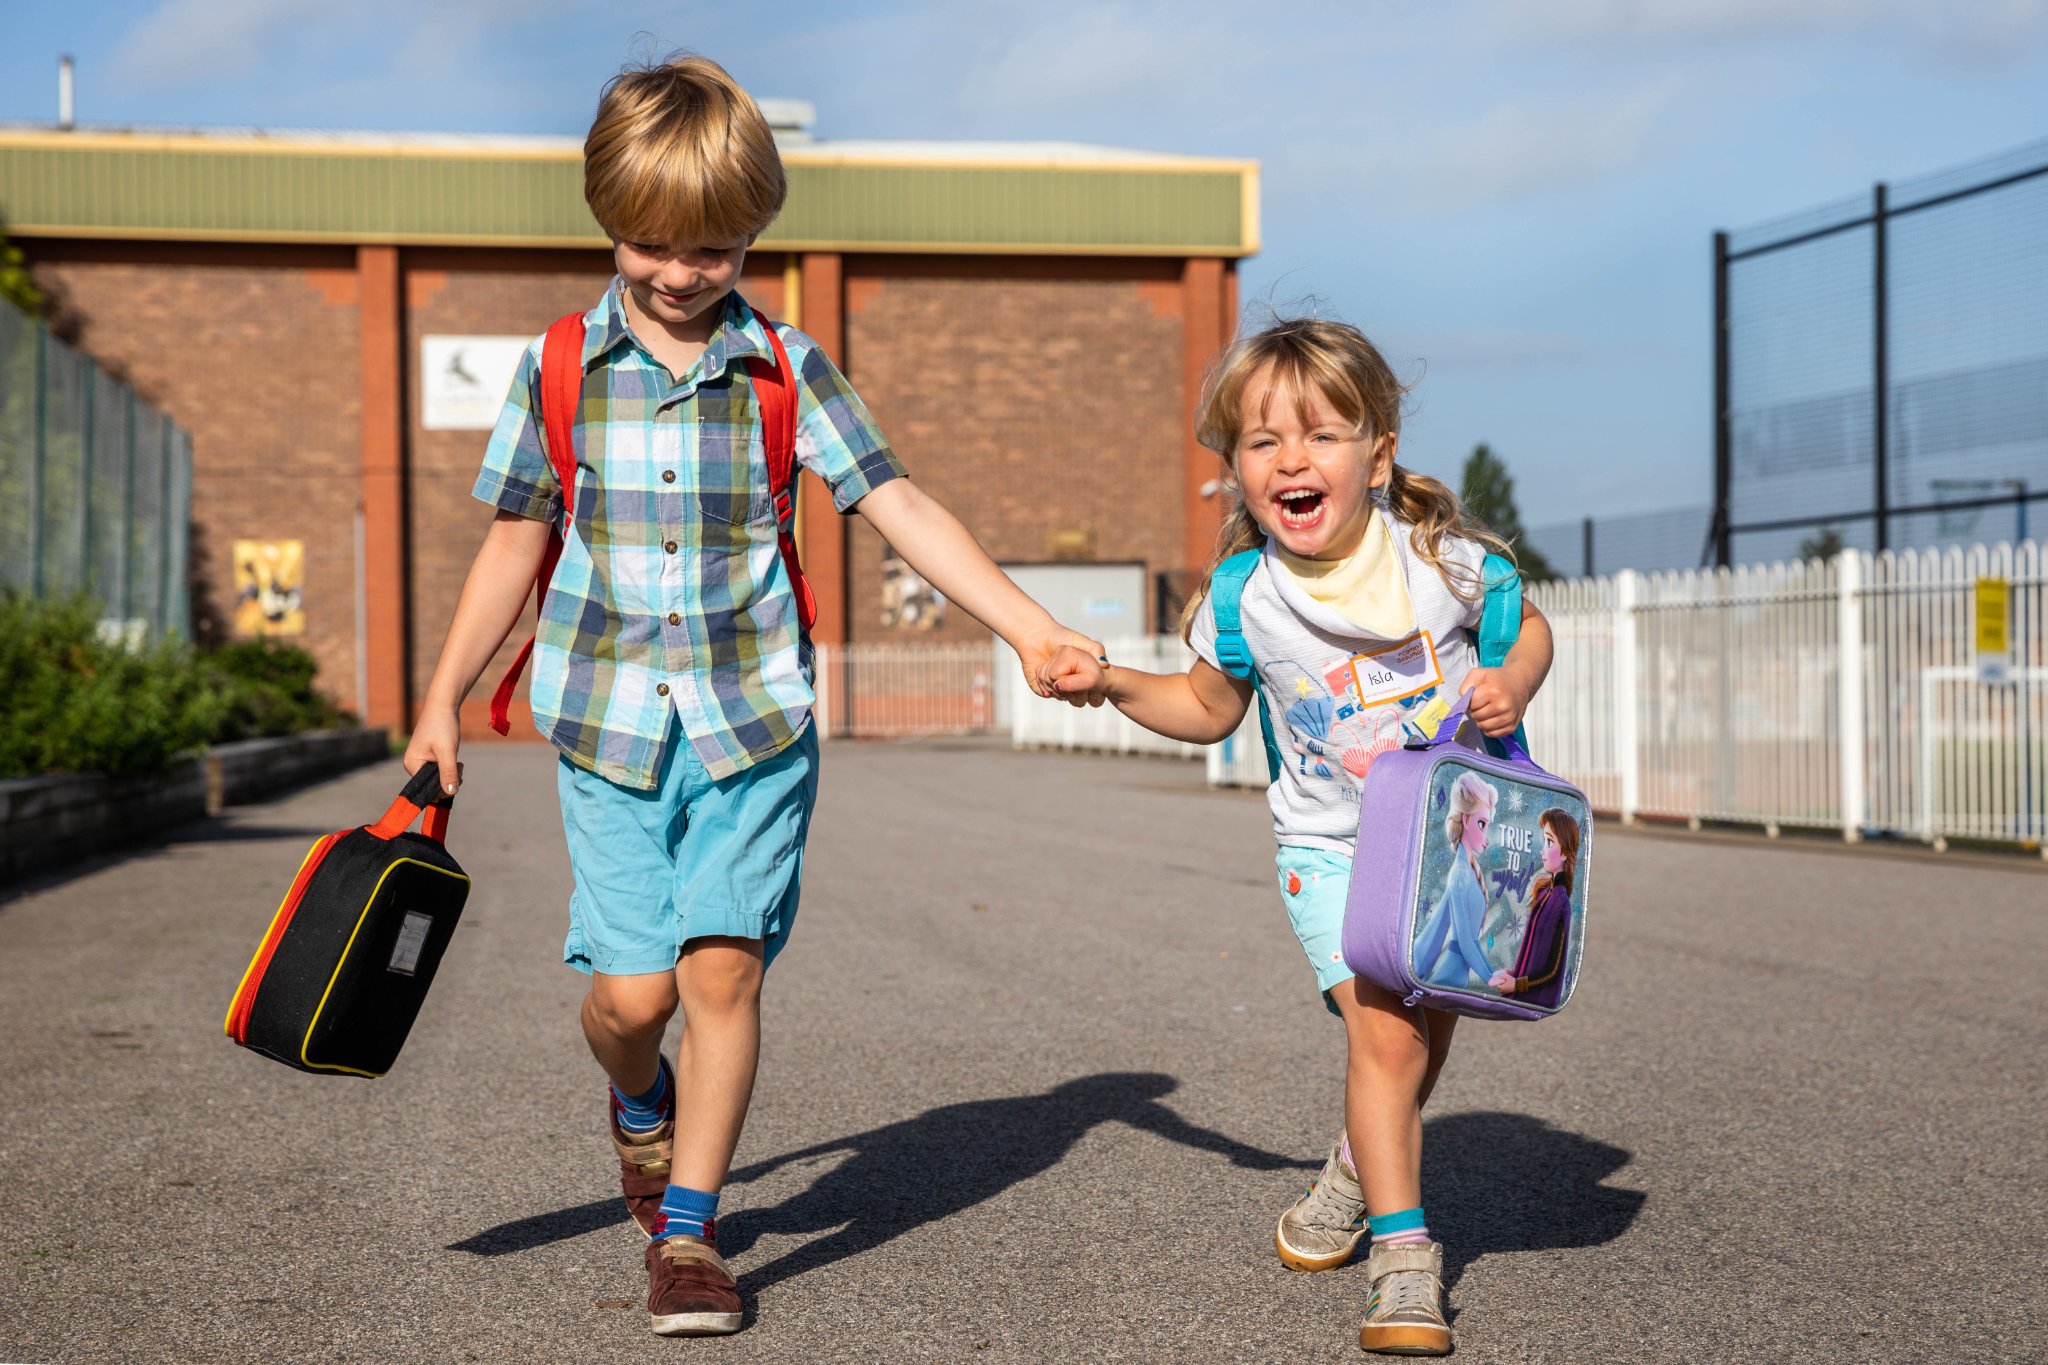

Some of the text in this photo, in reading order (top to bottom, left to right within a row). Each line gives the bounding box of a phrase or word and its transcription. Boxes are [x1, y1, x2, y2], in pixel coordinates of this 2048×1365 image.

[1367, 671, 1394, 686] Isla
[1498, 823, 1533, 854] TRUE
[1506, 850, 1521, 873] TO
[1491, 861, 1535, 903] myself
